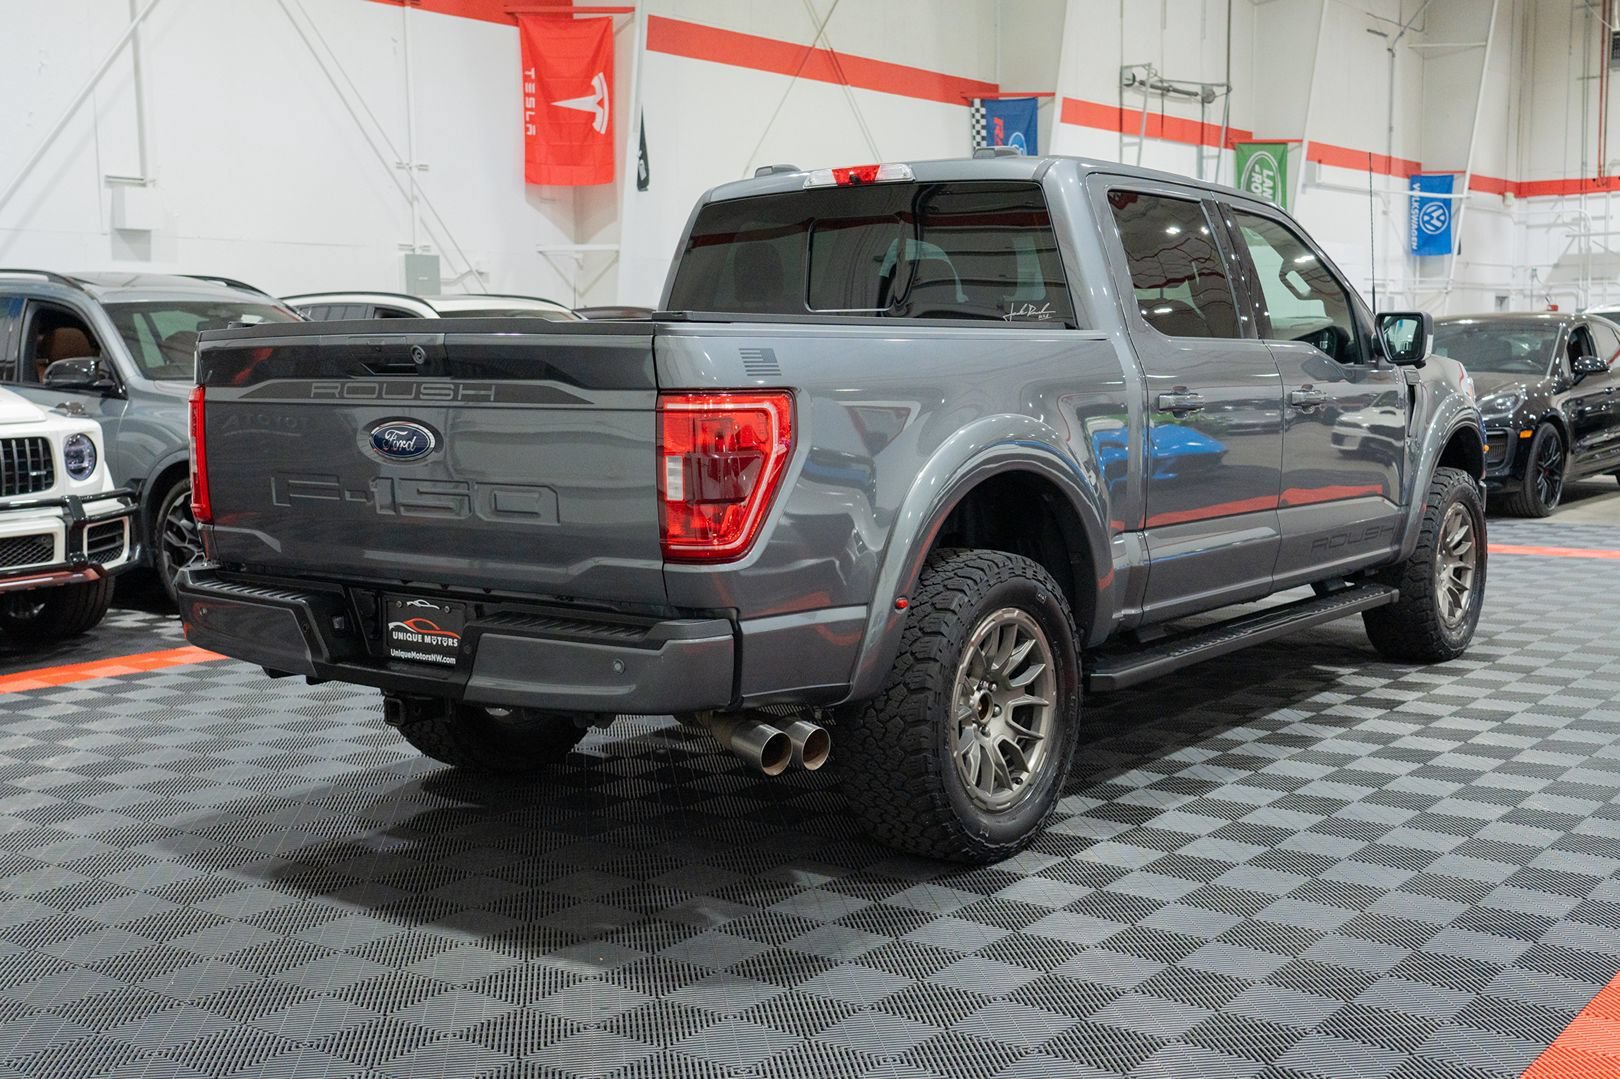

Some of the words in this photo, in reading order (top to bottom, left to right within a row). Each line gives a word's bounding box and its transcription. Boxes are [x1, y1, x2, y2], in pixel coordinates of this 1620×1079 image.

[524, 67, 536, 136] TESLA
[1262, 169, 1274, 199] LAN
[1411, 182, 1420, 250] VLKSWAGEN
[311, 382, 496, 401] ROUSH
[383, 429, 418, 452] Ford
[270, 471, 561, 526] F-150
[1311, 525, 1397, 553] ROUSH
[392, 631, 423, 643] UNIQUE
[424, 634, 459, 647] MOTORS
[390, 648, 456, 664] UniqueMotorsNW.com
